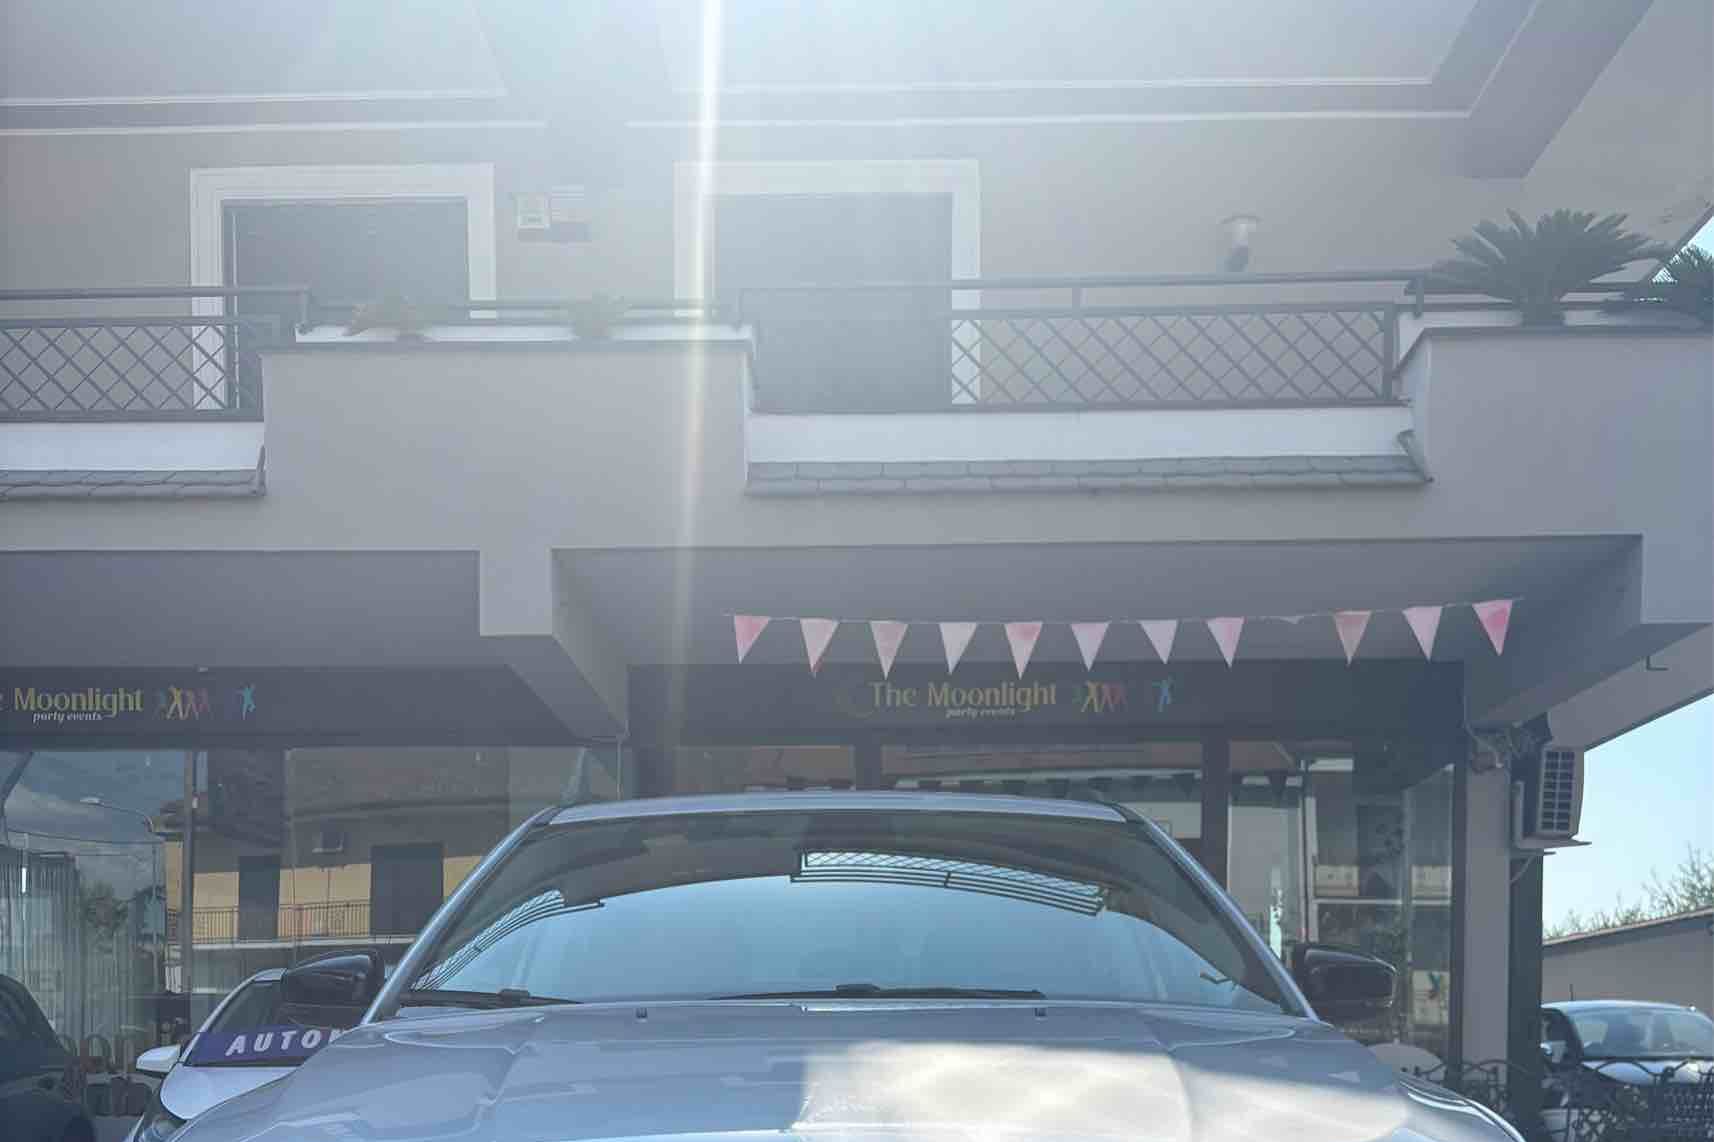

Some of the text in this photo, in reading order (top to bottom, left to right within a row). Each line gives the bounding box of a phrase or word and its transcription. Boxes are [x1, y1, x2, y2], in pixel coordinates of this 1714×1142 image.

[14, 687, 143, 717] Moonlight
[868, 681, 1056, 712] The Moonlight
[32, 710, 102, 724] party events
